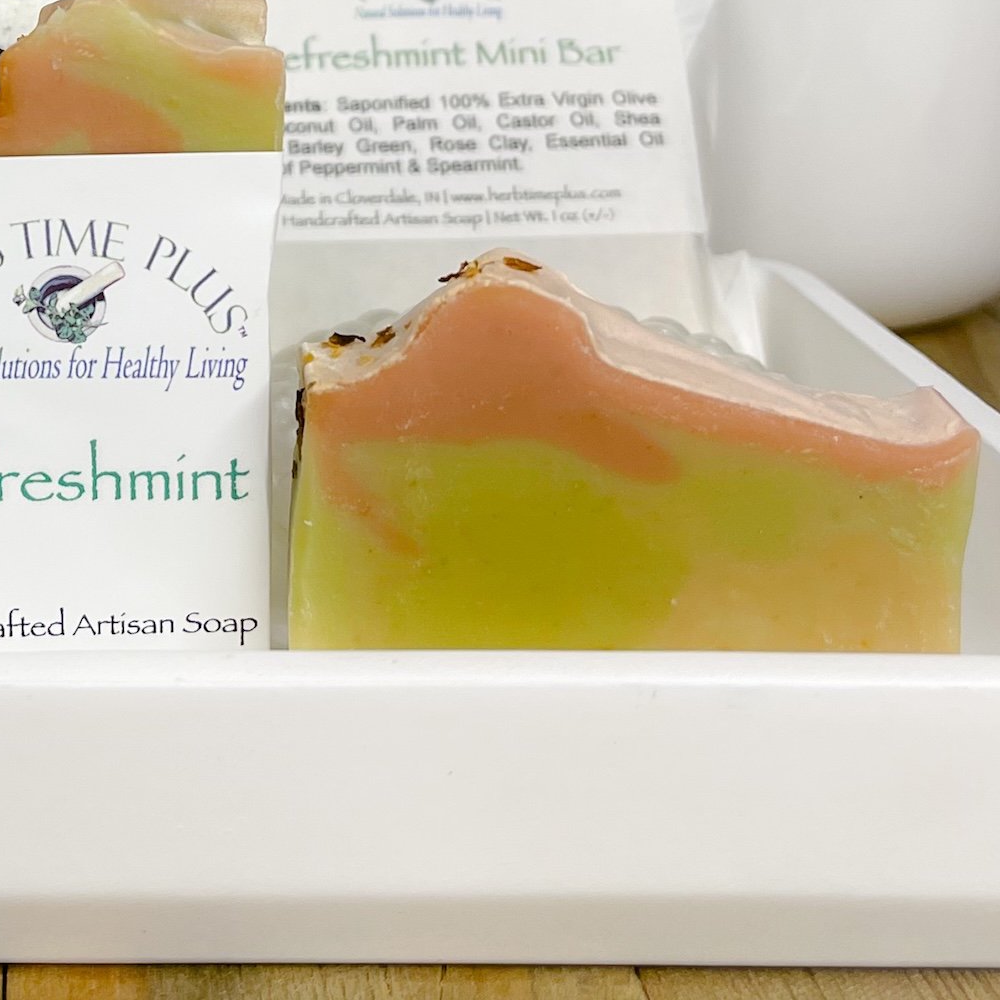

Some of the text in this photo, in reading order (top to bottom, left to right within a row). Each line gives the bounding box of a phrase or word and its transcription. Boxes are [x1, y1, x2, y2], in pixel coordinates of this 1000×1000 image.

[284, 33, 620, 70] efreshmint Mini Bar
[336, 94, 430, 116] Saponified
[440, 93, 490, 110] 100%
[498, 91, 546, 108] Extra
[552, 90, 604, 108] Virgin
[612, 89, 658, 105] Olive
[284, 109, 662, 135] conut Oil, Palm Oil, Castor Oil, Shea
[288, 138, 344, 157] Barley
[355, 136, 418, 155] Green,
[429, 135, 477, 152] Rose
[545, 132, 628, 150] Essential
[638, 130, 665, 148] Oil
[299, 159, 402, 179] Peppermint
[407, 158, 422, 174] &
[426, 156, 525, 177] Spearmint.
[281, 209, 381, 228] Handcrafted
[382, 211, 438, 227] Artisan
[441, 210, 484, 232] Soap
[494, 210, 520, 224] Net
[9, 218, 130, 262] TIME
[67, 345, 97, 380] for
[103, 344, 180, 392] Healthy
[184, 346, 249, 391] Living
[71, 612, 175, 637] Artisan
[181, 611, 259, 646] Soap
